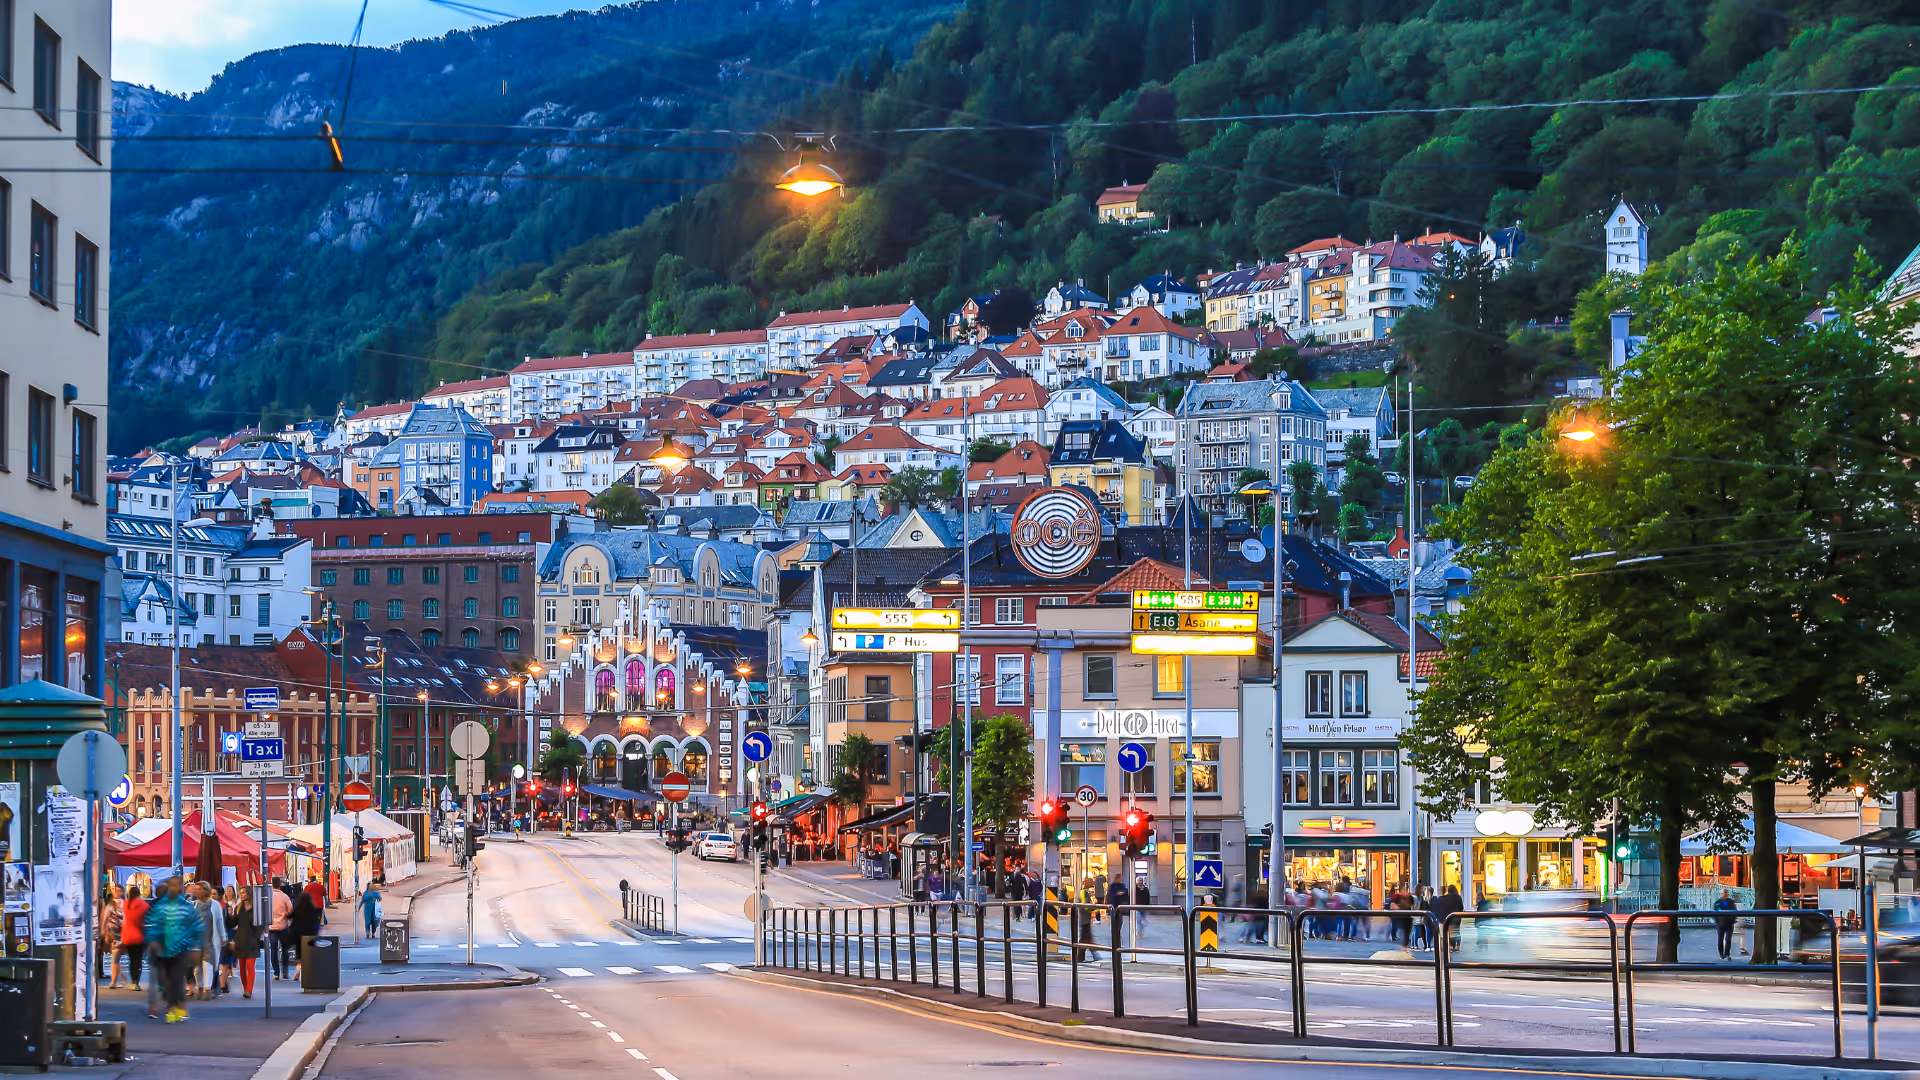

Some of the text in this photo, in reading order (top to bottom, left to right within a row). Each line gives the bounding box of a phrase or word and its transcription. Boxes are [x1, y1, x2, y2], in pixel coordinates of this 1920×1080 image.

[1015, 508, 1096, 549] océ
[1151, 594, 1241, 606] E 16 585 E 39 N
[885, 613, 908, 624] 555
[1153, 616, 1161, 627] E
[1163, 616, 1175, 627] 16
[1184, 613, 1221, 628] Åsane
[1097, 710, 1121, 734] Deli
[1150, 710, 1178, 734] Luca
[245, 741, 279, 756] Taxi
[261, 769, 276, 777] dager
[1079, 790, 1094, 802] 30
